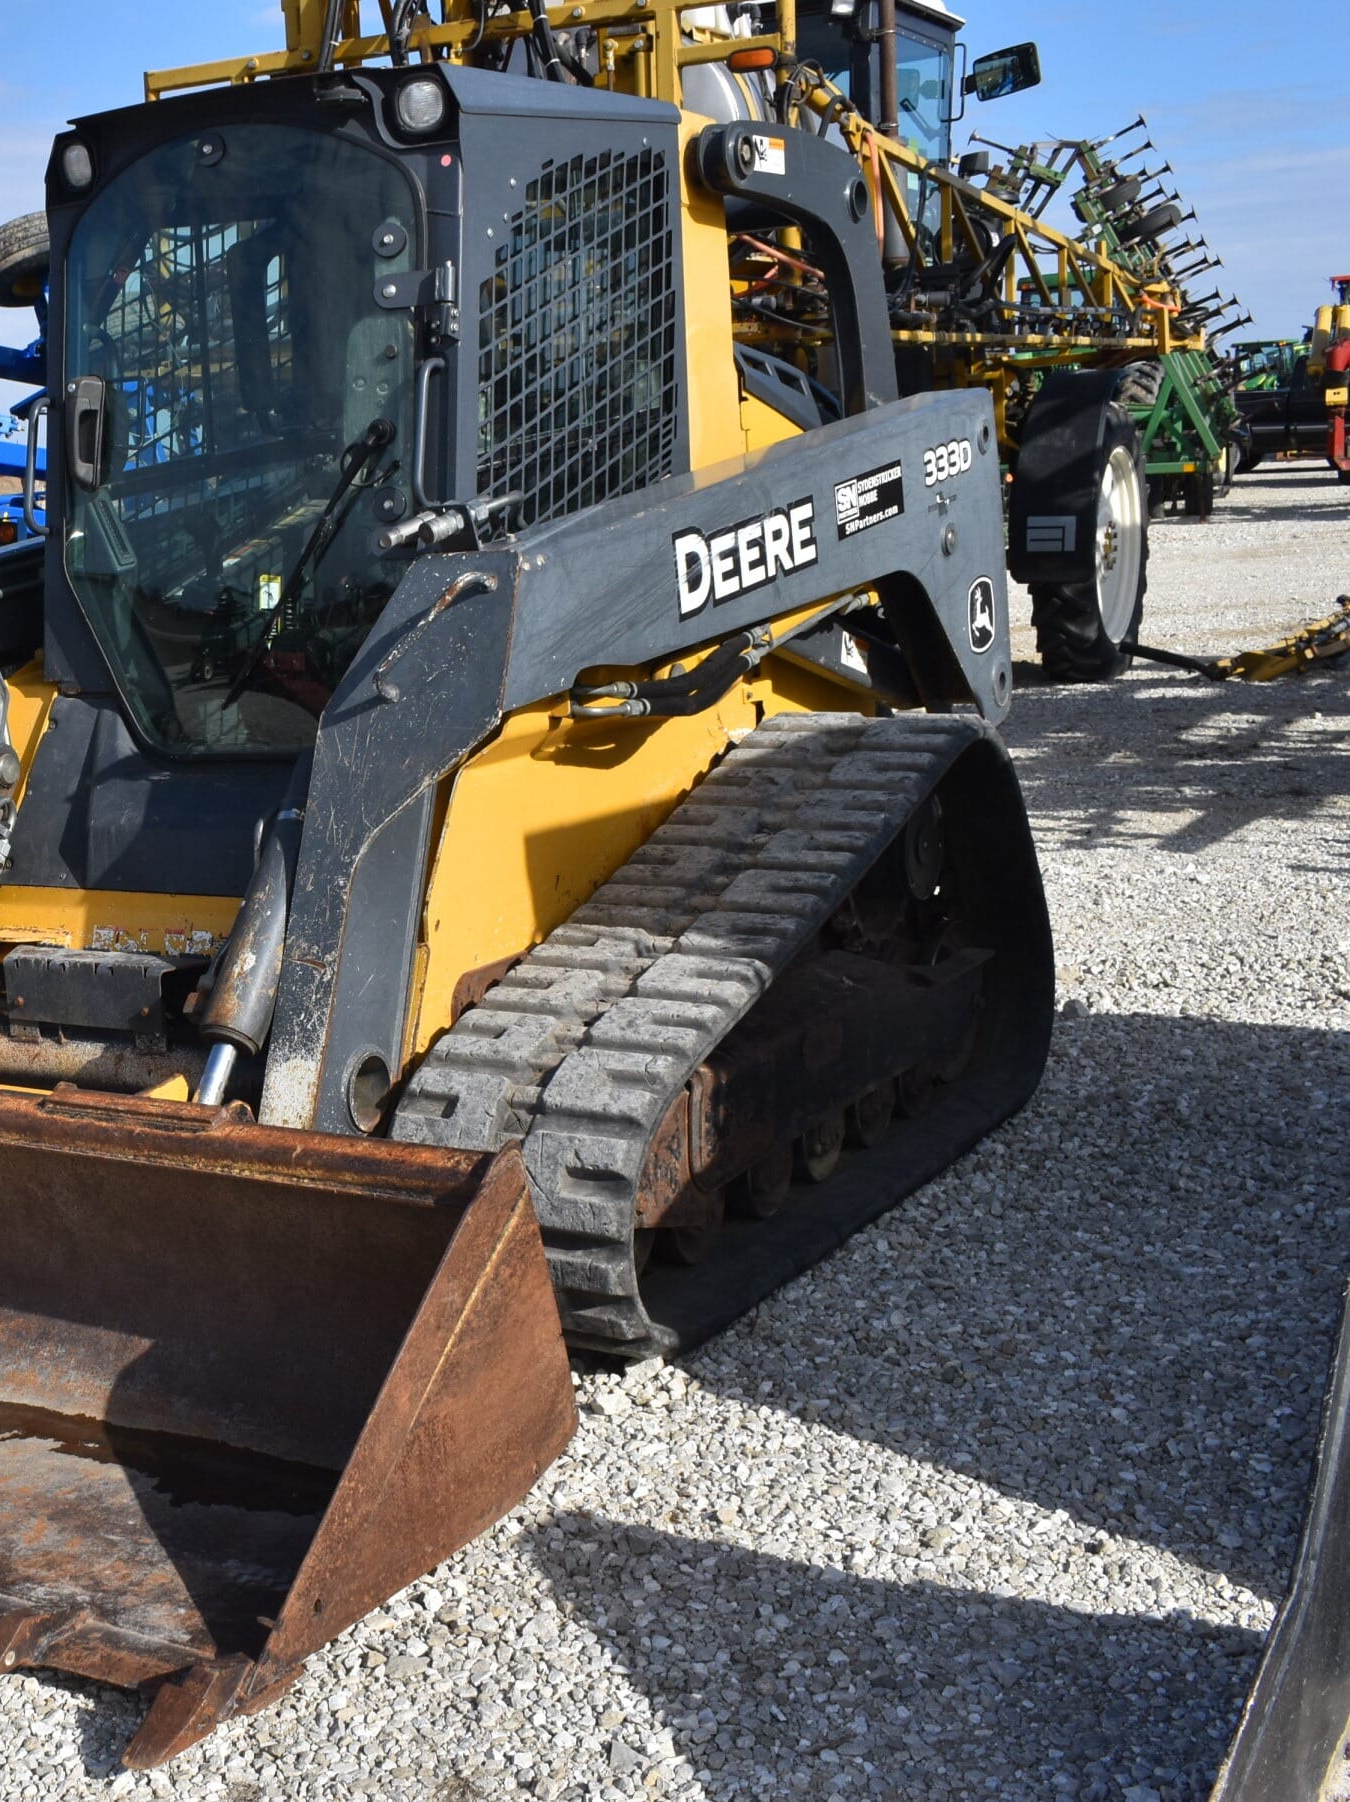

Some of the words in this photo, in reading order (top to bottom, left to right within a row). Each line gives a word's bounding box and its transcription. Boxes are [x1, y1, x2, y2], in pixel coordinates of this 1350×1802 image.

[923, 439, 972, 487] 333D
[837, 483, 858, 512] SN
[845, 505, 899, 535] SNPartners.com
[673, 500, 818, 616] DEERE
